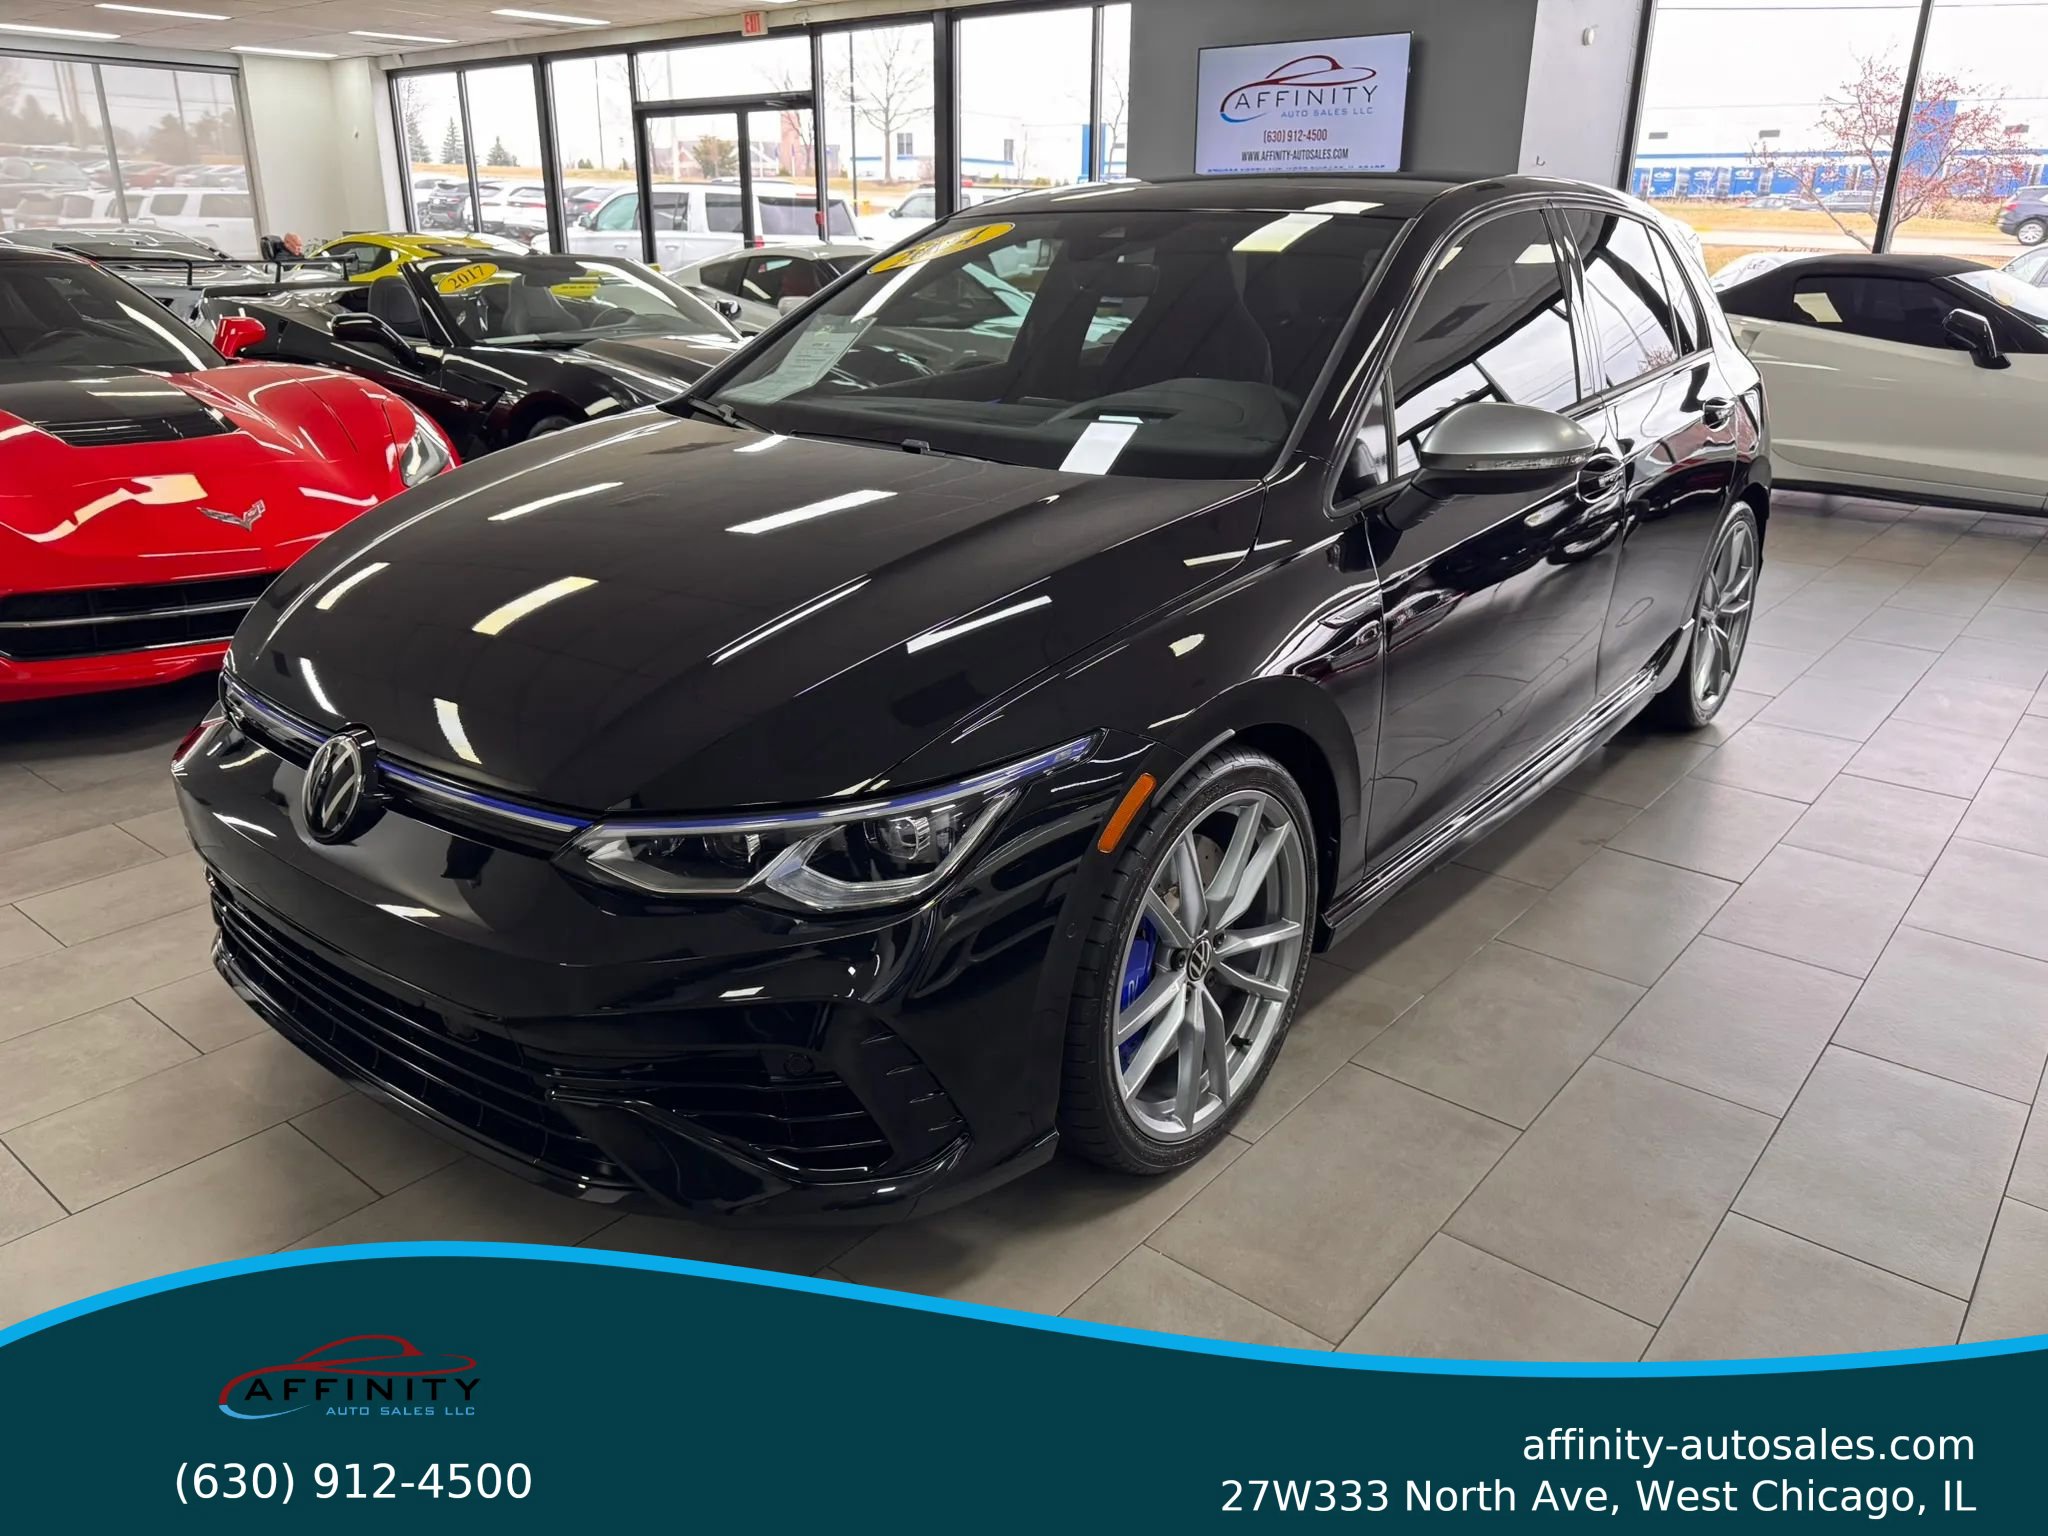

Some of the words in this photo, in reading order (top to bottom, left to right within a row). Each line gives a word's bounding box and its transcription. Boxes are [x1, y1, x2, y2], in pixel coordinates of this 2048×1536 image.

[1234, 85, 1378, 109] AFFINITY
[1281, 109, 1309, 118] AUTO
[1313, 108, 1348, 117] SALES
[1353, 106, 1374, 115] LLC
[1263, 130, 1286, 144] (630)
[1287, 128, 1328, 142] 912-4500
[1241, 148, 1349, 162] WWW.AFFINITY-AUTOSALES.COM
[447, 265, 485, 290] 2017
